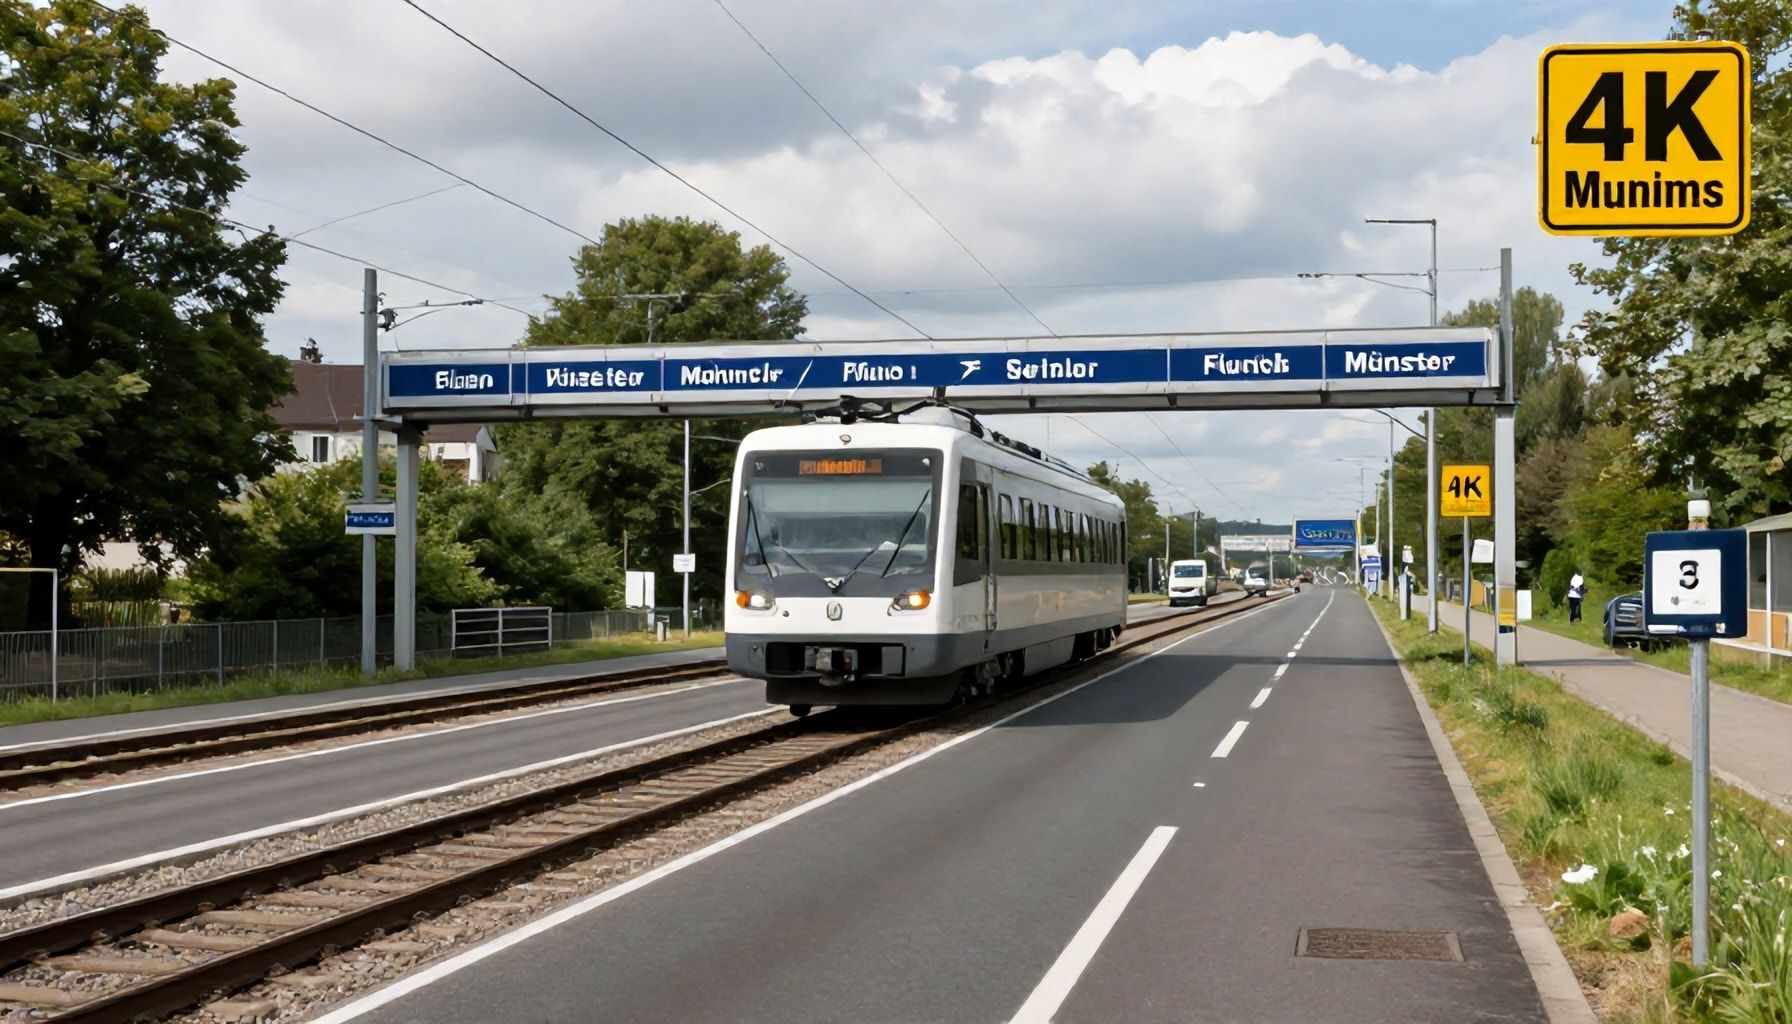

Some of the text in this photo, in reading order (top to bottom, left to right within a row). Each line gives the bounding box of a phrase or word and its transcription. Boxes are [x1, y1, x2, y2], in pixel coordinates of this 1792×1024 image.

[1565, 70, 1724, 162] 4K
[1565, 170, 1724, 209] Munims
[1679, 560, 1699, 590] 3
